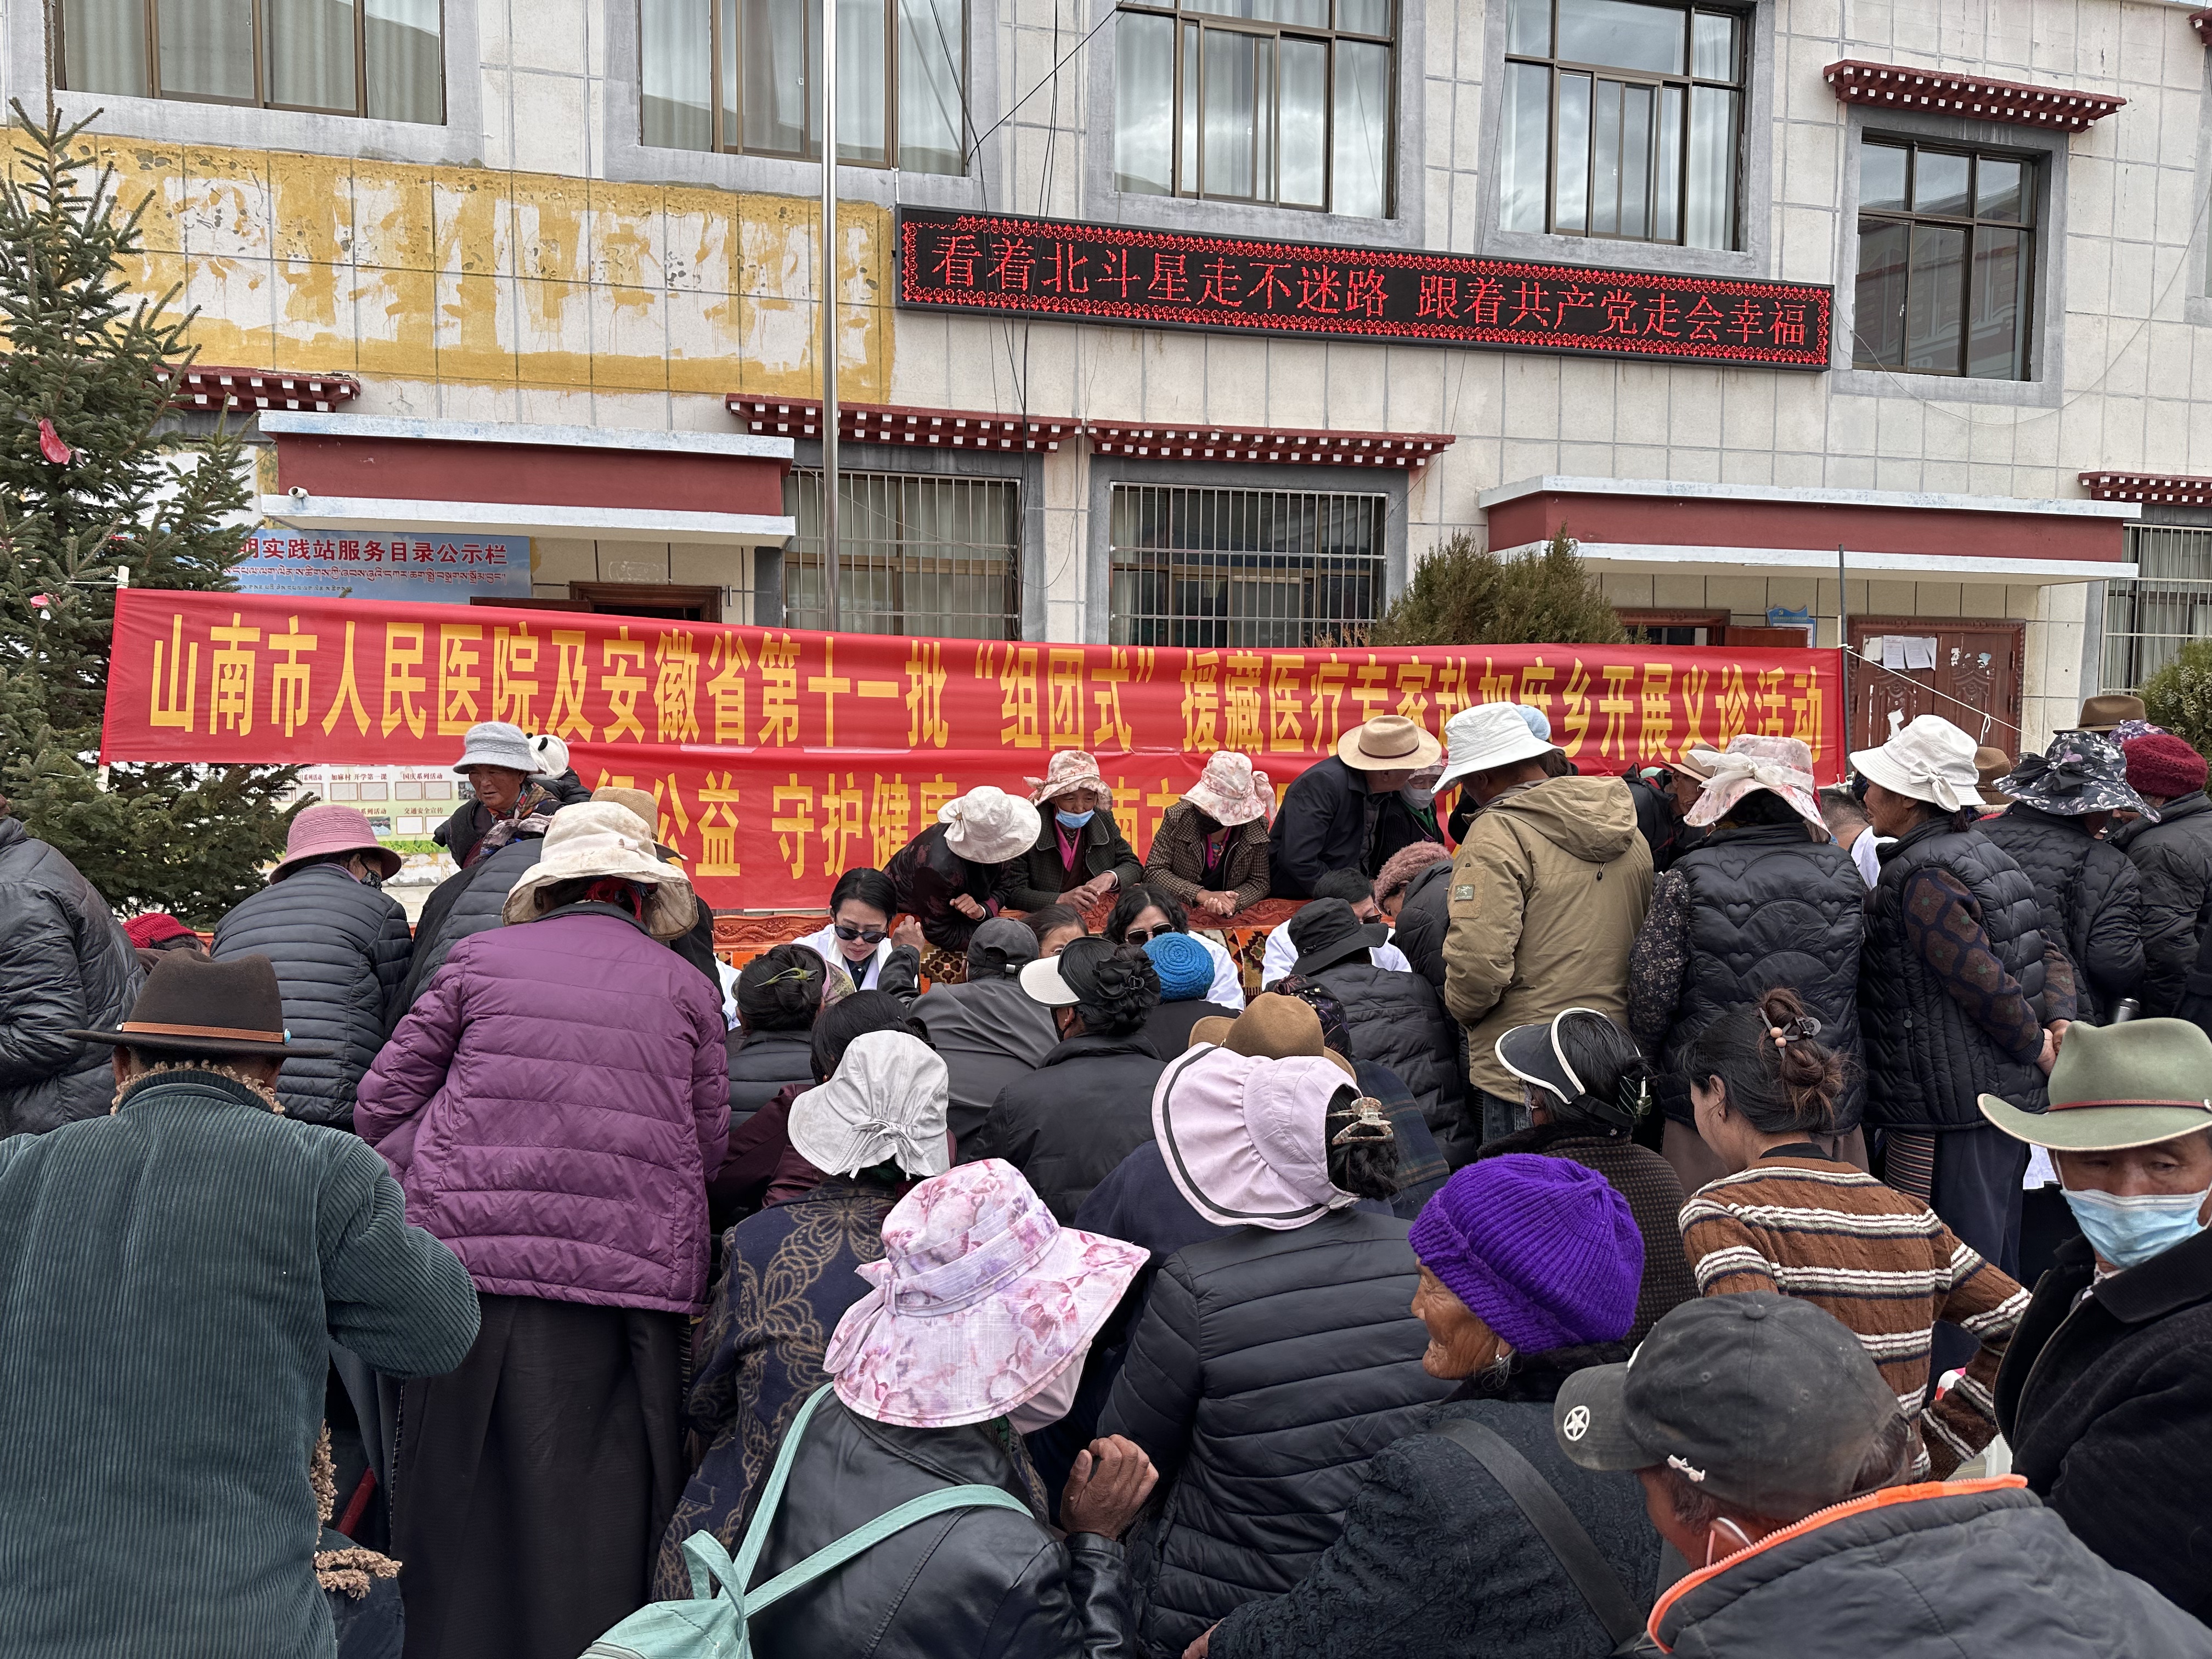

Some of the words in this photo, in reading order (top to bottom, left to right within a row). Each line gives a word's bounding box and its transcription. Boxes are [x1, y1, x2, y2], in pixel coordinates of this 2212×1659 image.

[932, 235, 1389, 317] 看着北斗星走不迷路
[1415, 274, 1807, 346] 跟着共产党走会幸福
